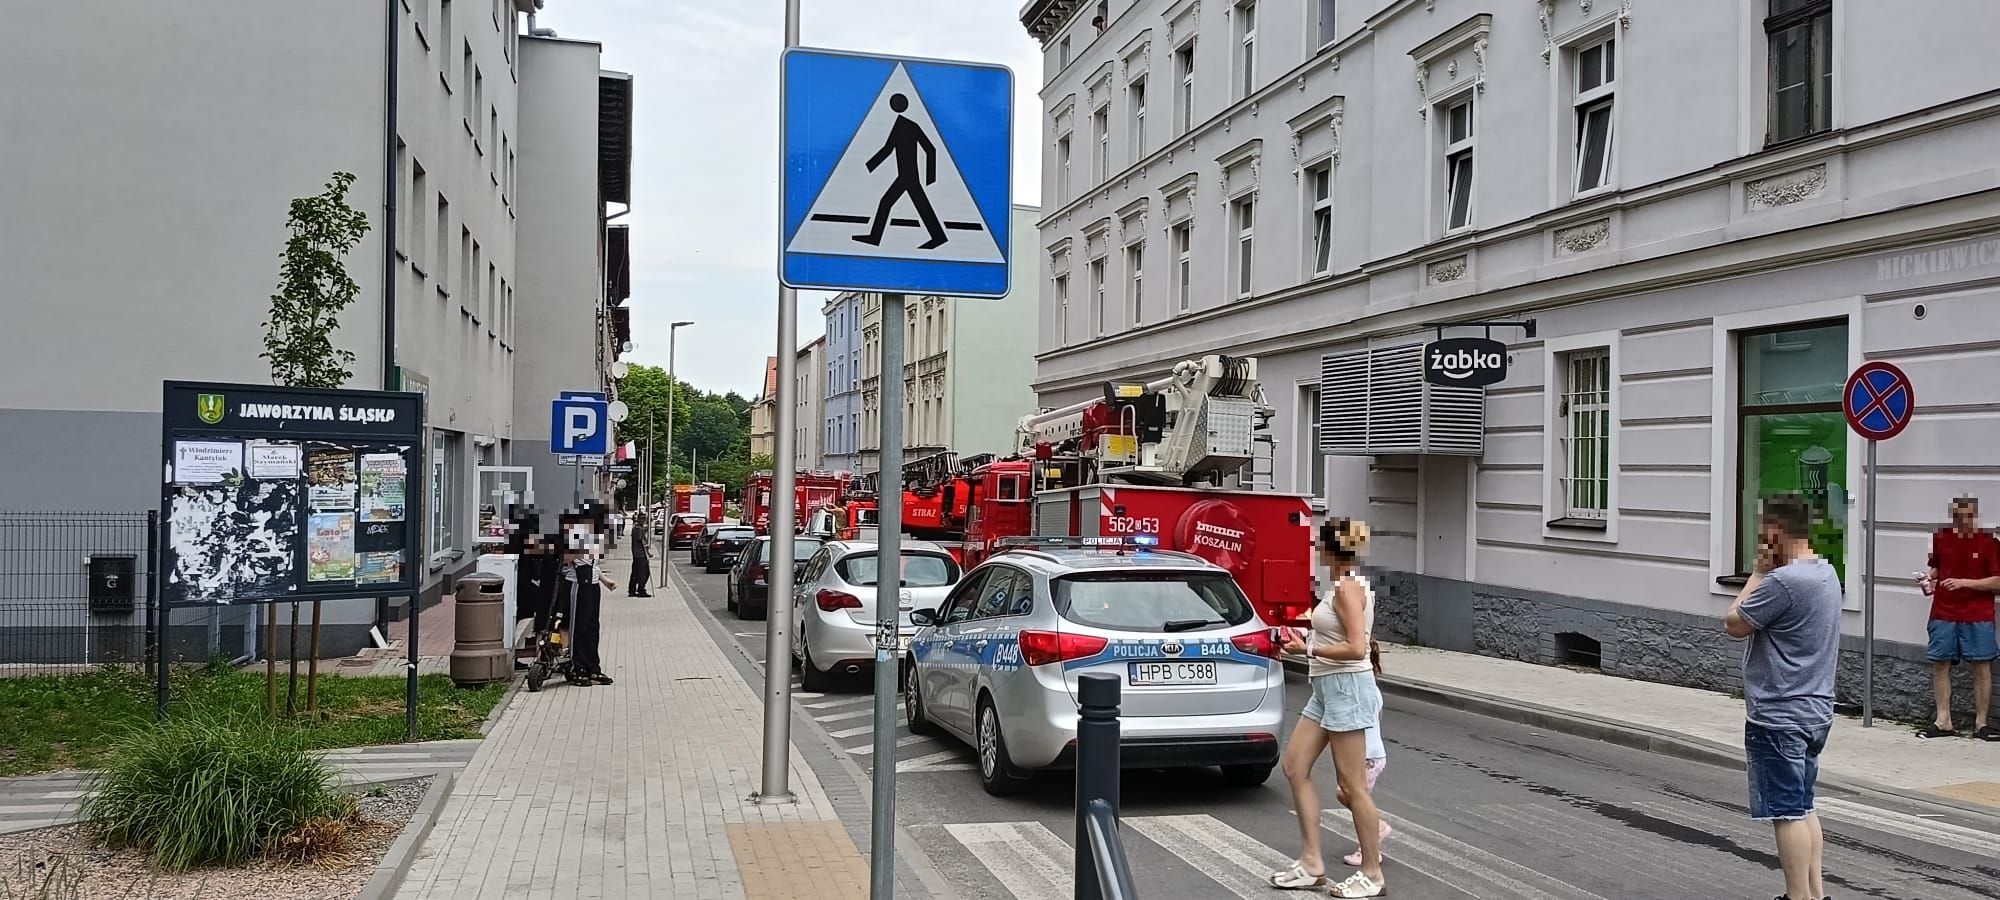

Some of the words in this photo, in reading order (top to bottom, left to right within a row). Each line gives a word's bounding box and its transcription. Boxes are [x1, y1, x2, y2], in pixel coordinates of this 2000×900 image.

[1431, 348, 1501, 370] żabka
[239, 403, 334, 421] JAWORZYNA
[339, 404, 395, 424] ŚLĄSKA
[564, 406, 597, 448] P
[1193, 534, 1242, 553] KOSZALIN
[996, 643, 1019, 664] B448
[1113, 645, 1159, 657] POLICJA
[1201, 643, 1231, 656] B448
[1139, 664, 1173, 680] HPB
[1178, 663, 1214, 679] C588
